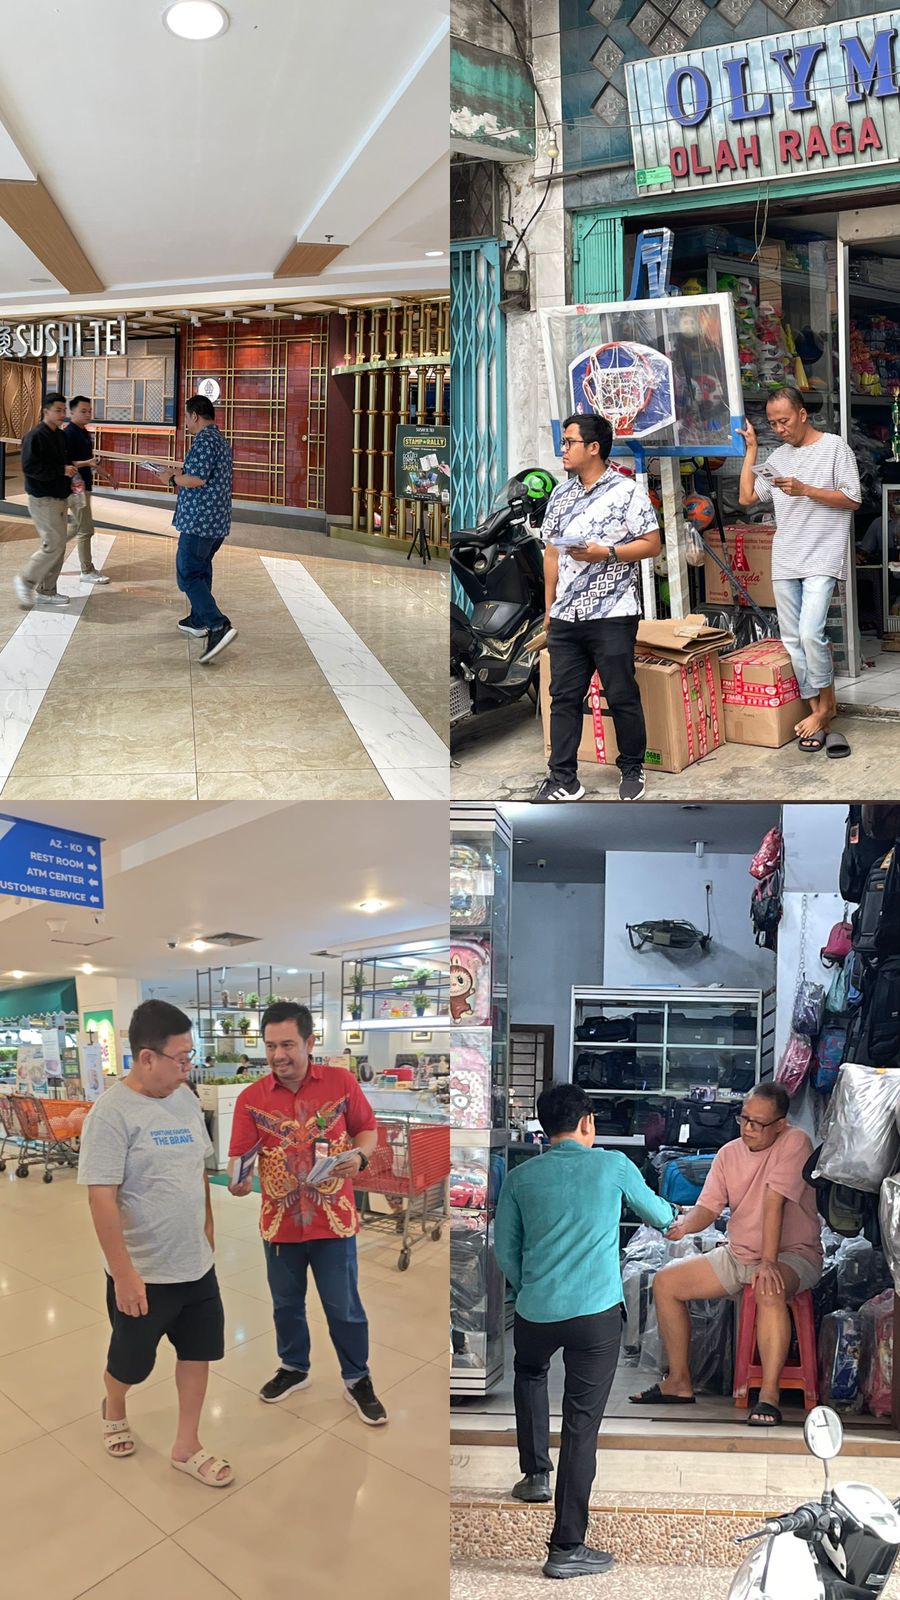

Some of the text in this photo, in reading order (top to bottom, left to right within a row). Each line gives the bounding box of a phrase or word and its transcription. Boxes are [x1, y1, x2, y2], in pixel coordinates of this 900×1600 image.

[666, 28, 900, 127] OLYM
[669, 116, 882, 177] OLAH RAGA
[16, 322, 82, 357] SUSHI
[90, 320, 127, 356] TEI
[49, 839, 62, 848] AZ
[70, 843, 83, 852] KO
[30, 851, 84, 869] REST ROOM
[26, 867, 84, 884] ATM CENTER
[0, 880, 86, 901] USTOMER SERVICE
[152, 1134, 194, 1146] THE BRAVE
